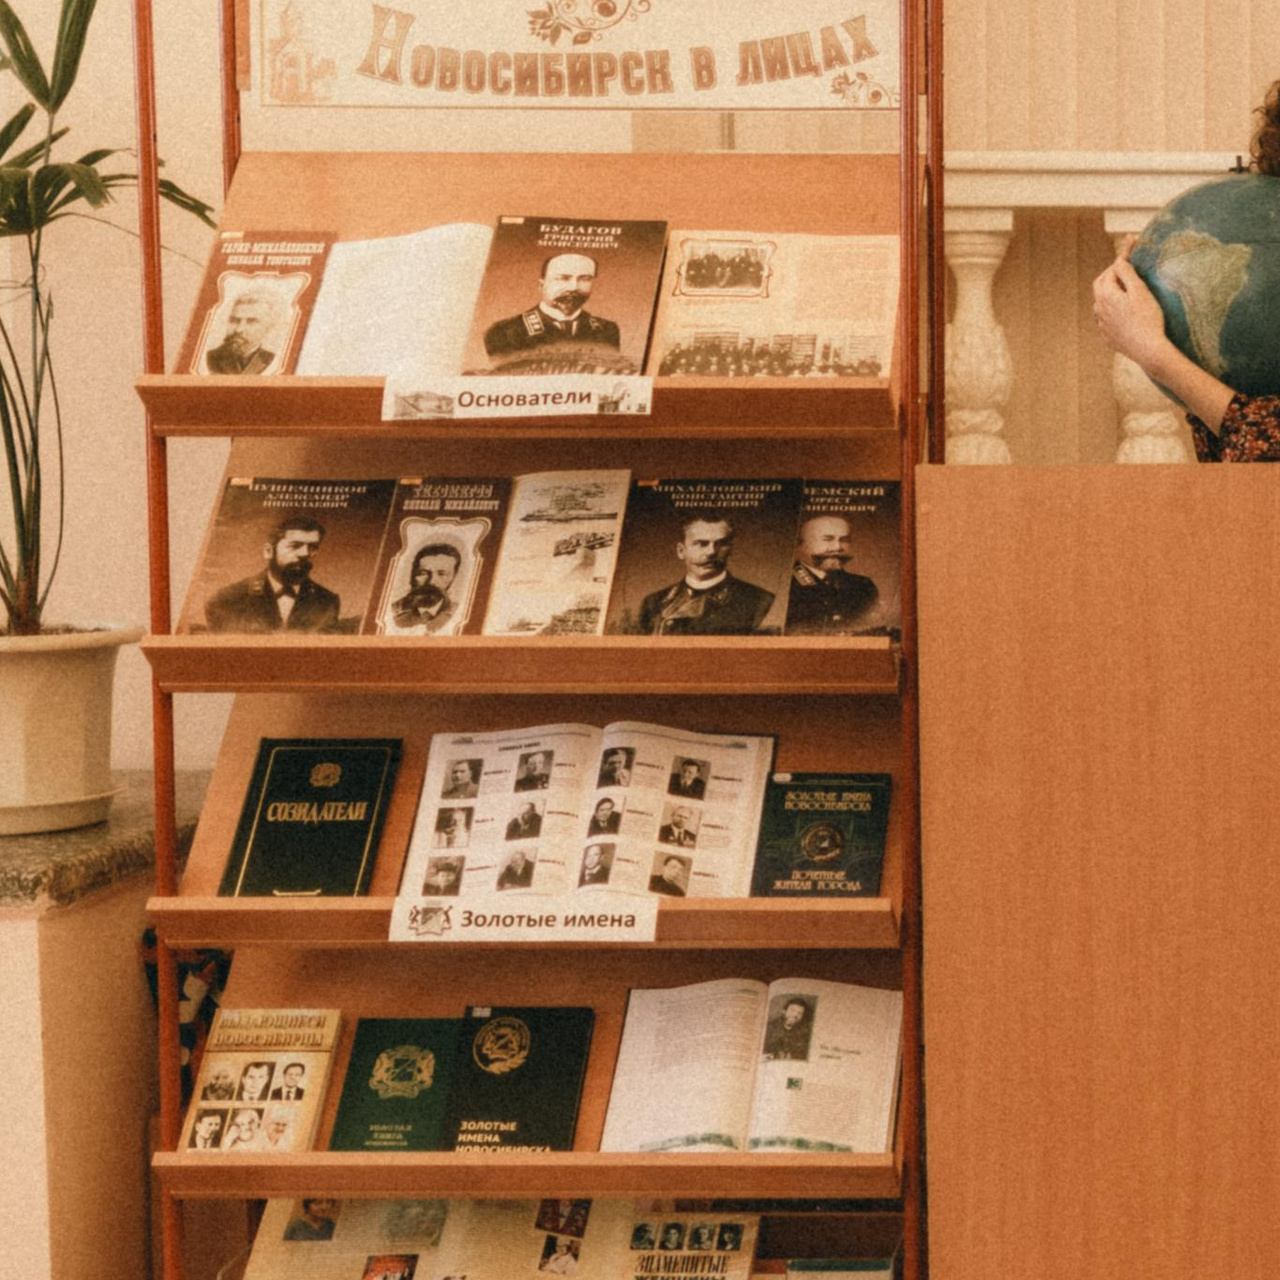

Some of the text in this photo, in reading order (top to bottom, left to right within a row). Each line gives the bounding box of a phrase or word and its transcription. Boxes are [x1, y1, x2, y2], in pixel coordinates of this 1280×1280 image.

[735, 14, 880, 87] ЛИЦАХ
[539, 224, 622, 235] БУДАГОВ
[458, 391, 592, 408] Основатели
[266, 802, 369, 825] СОЗИДАТЕЛИ
[461, 910, 637, 928] Золотые имена
[460, 1121, 518, 1132] ЗОЛОТЫЕ
[457, 1133, 501, 1143] ИМЕНА
